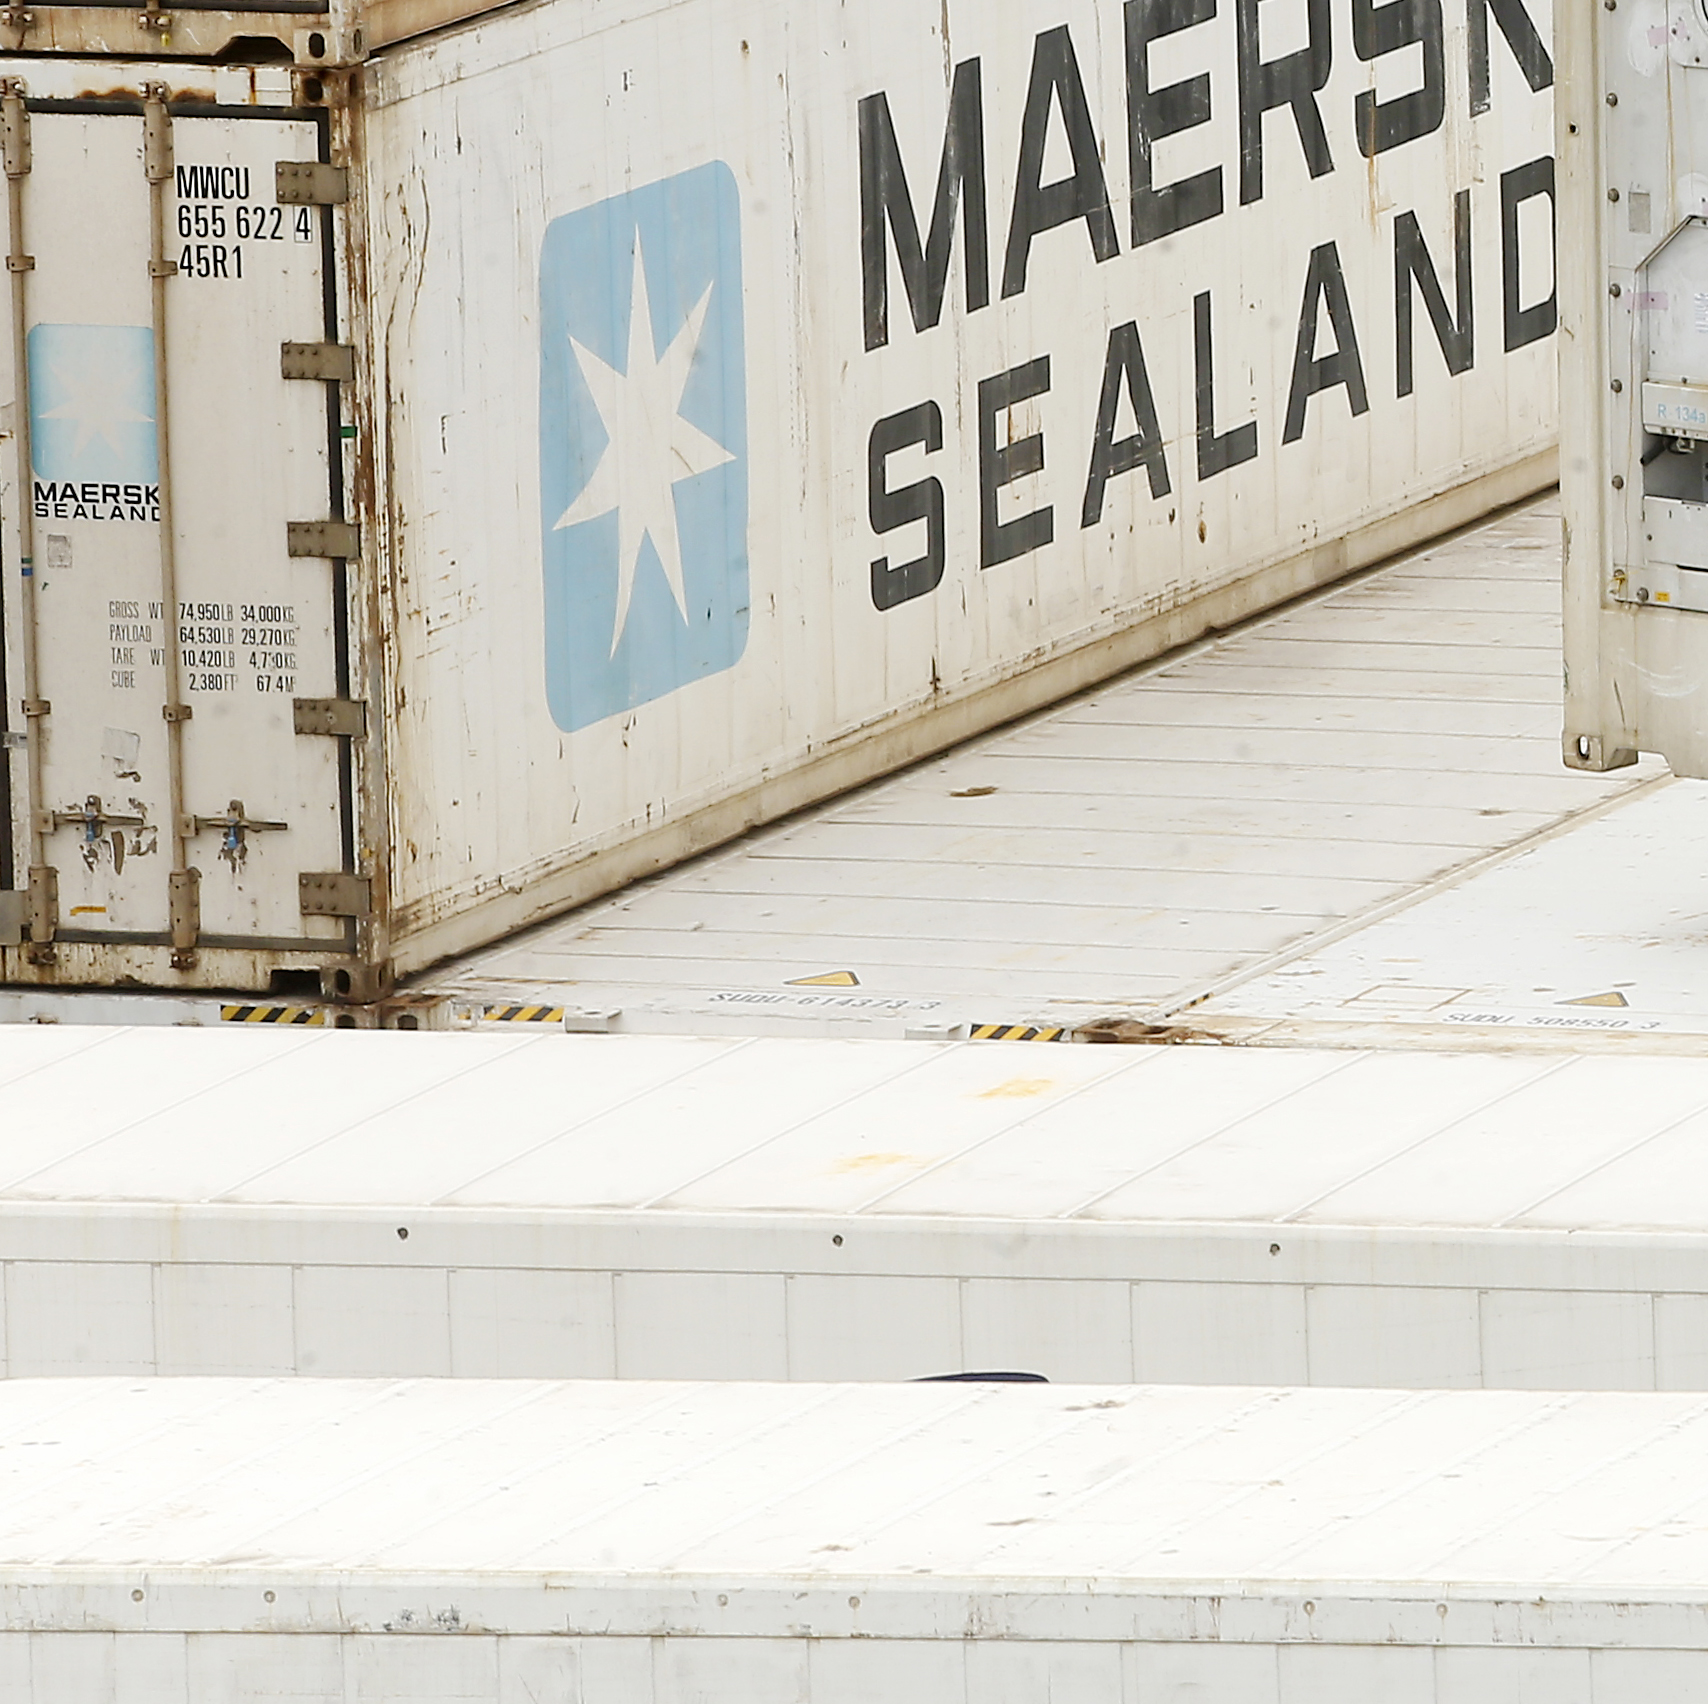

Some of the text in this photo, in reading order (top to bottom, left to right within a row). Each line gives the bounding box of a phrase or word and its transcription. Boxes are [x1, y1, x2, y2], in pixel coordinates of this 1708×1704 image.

[176, 165, 250, 199] MWCU
[177, 205, 311, 241] 655 622 4
[179, 244, 243, 279] 45R1
[869, 154, 1557, 613] SEALAND
[34, 482, 160, 505] MAERSK
[109, 600, 139, 619] GROSS
[110, 624, 151, 643] PAYLOAD
[111, 647, 135, 665] TARE
